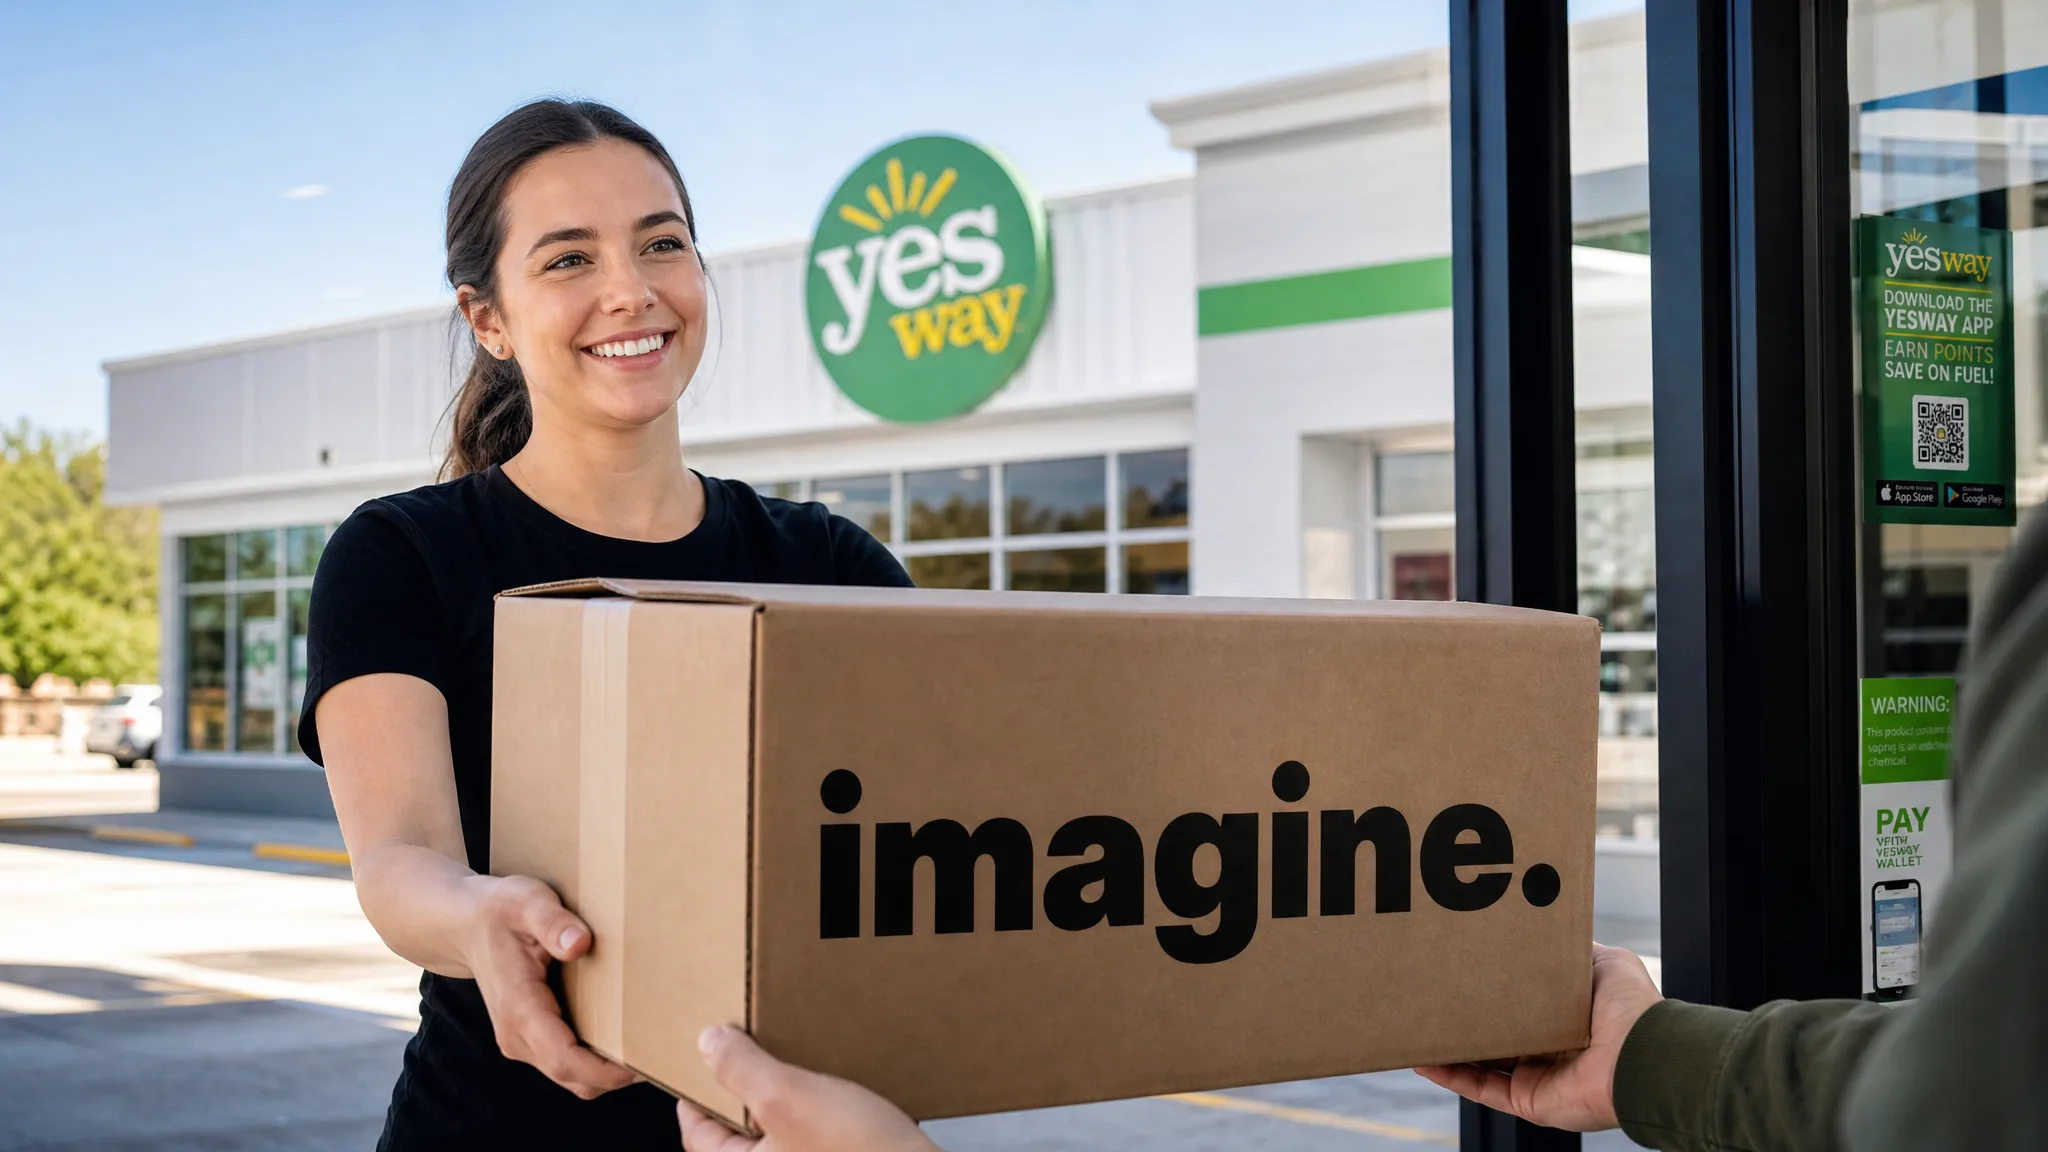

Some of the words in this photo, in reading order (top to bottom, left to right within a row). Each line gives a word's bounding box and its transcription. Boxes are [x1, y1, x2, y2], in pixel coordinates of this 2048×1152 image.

[815, 204, 1004, 356] yes
[1884, 289, 1964, 311] DOWNLOAD
[1968, 297, 1993, 314] THE
[889, 283, 1027, 361] way
[1884, 308, 1958, 333] YESWAY
[1962, 315, 1994, 335] APP
[1885, 339, 1928, 360] EARN
[1934, 343, 1994, 364] POINTS
[1885, 360, 1923, 380] SAVE
[1928, 364, 1950, 382] ON
[1955, 366, 1994, 385] FUEL!
[1895, 491, 1912, 504] App
[1912, 492, 1934, 503] Store
[1962, 493, 1987, 506] Google
[1870, 695, 1950, 715] WARNING:
[1876, 806, 1931, 835] PAY
[820, 760, 1561, 964] imagine.
[1876, 855, 1923, 869] WALLET
